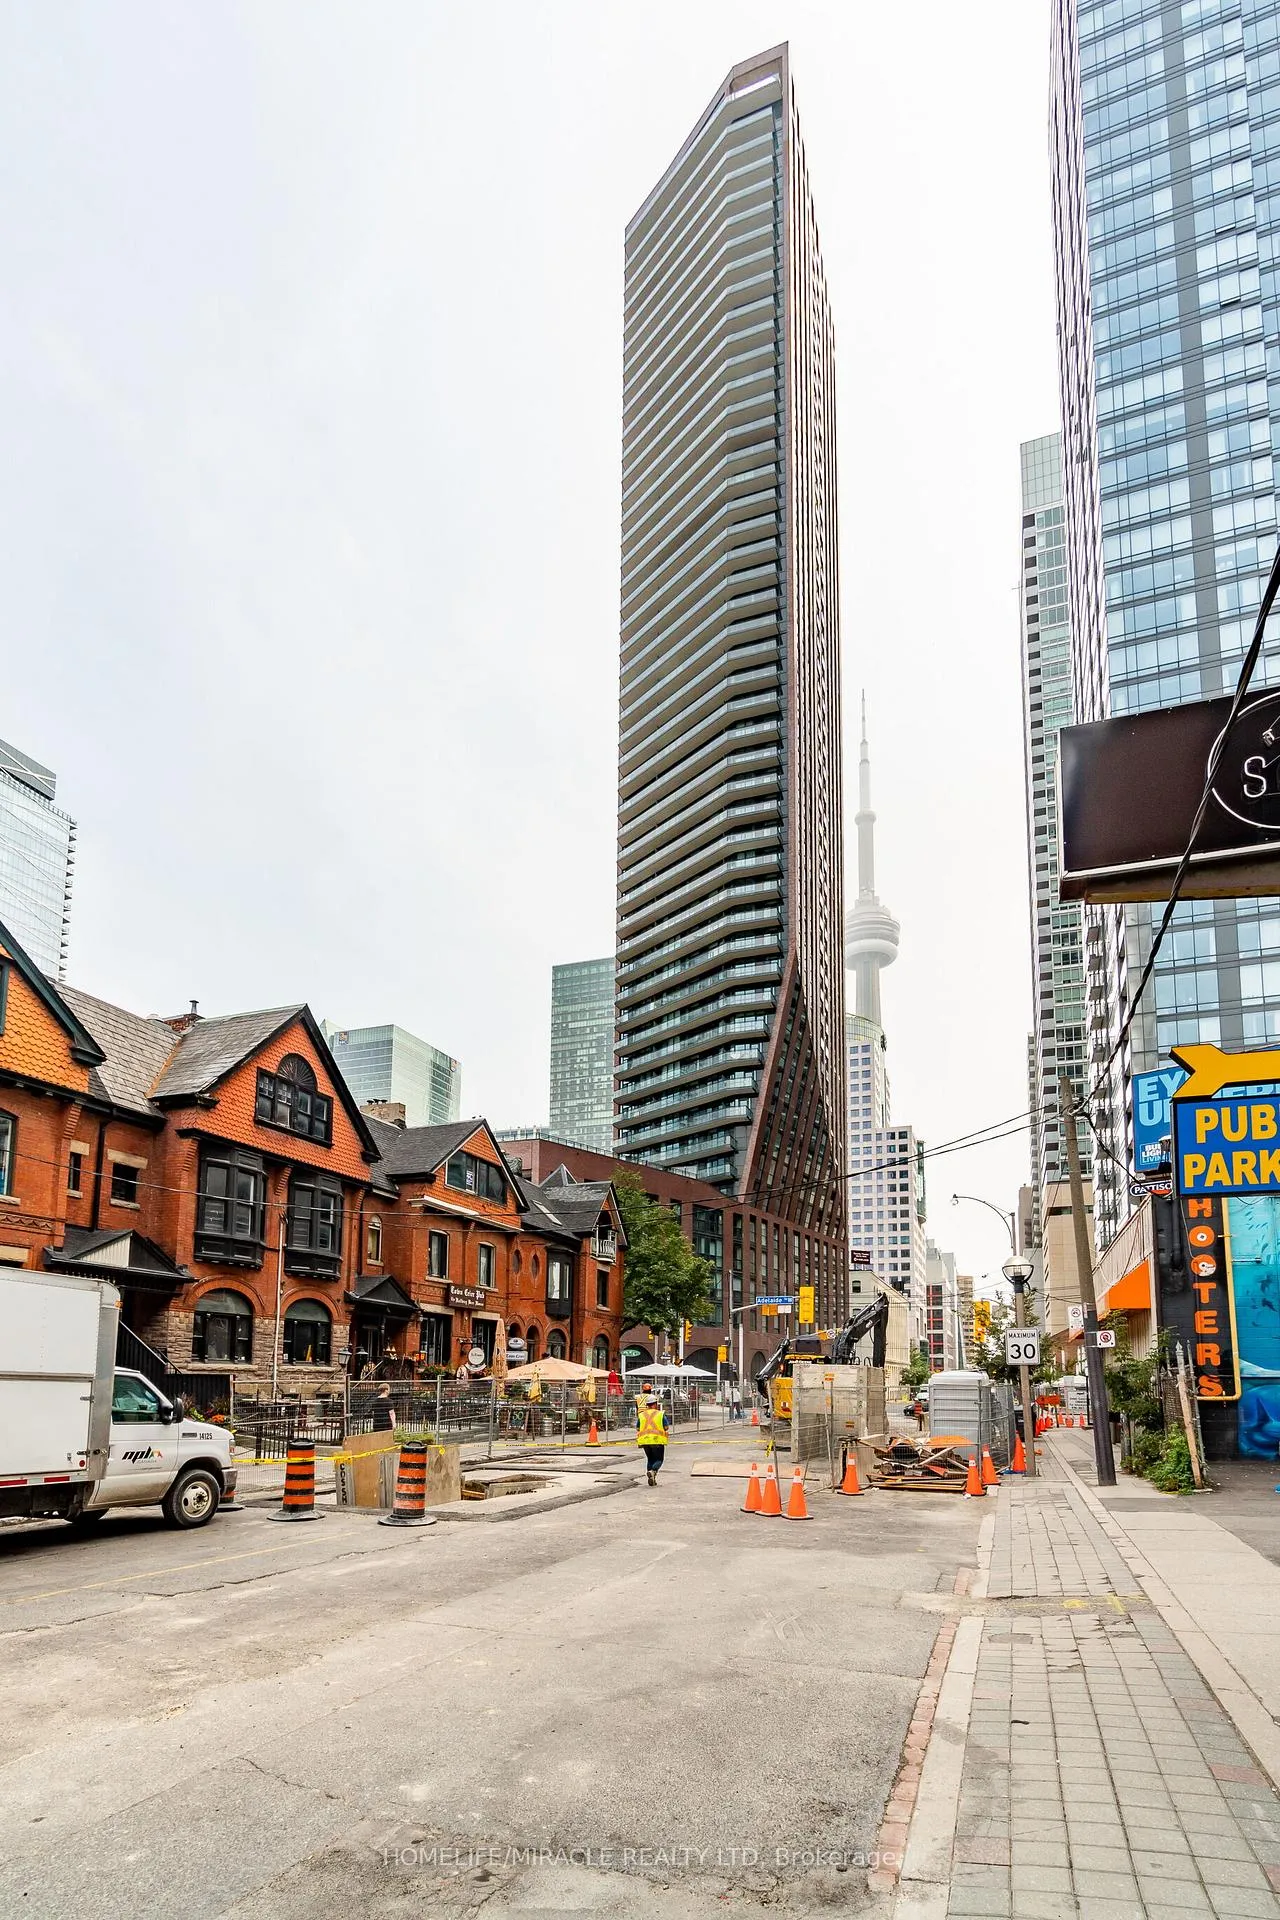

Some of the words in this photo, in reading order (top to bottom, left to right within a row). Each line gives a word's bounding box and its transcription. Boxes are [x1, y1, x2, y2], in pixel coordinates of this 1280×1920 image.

[1243, 756, 1272, 799] S
[1138, 1070, 1191, 1102] EY
[1195, 1104, 1280, 1144] PUB
[1142, 1150, 1162, 1158] LIGH
[1188, 1199, 1223, 1396] HOOTERS
[1010, 1343, 1036, 1360] 30
[199, 1432, 213, 1440] 14125
[121, 1446, 152, 1464] npl
